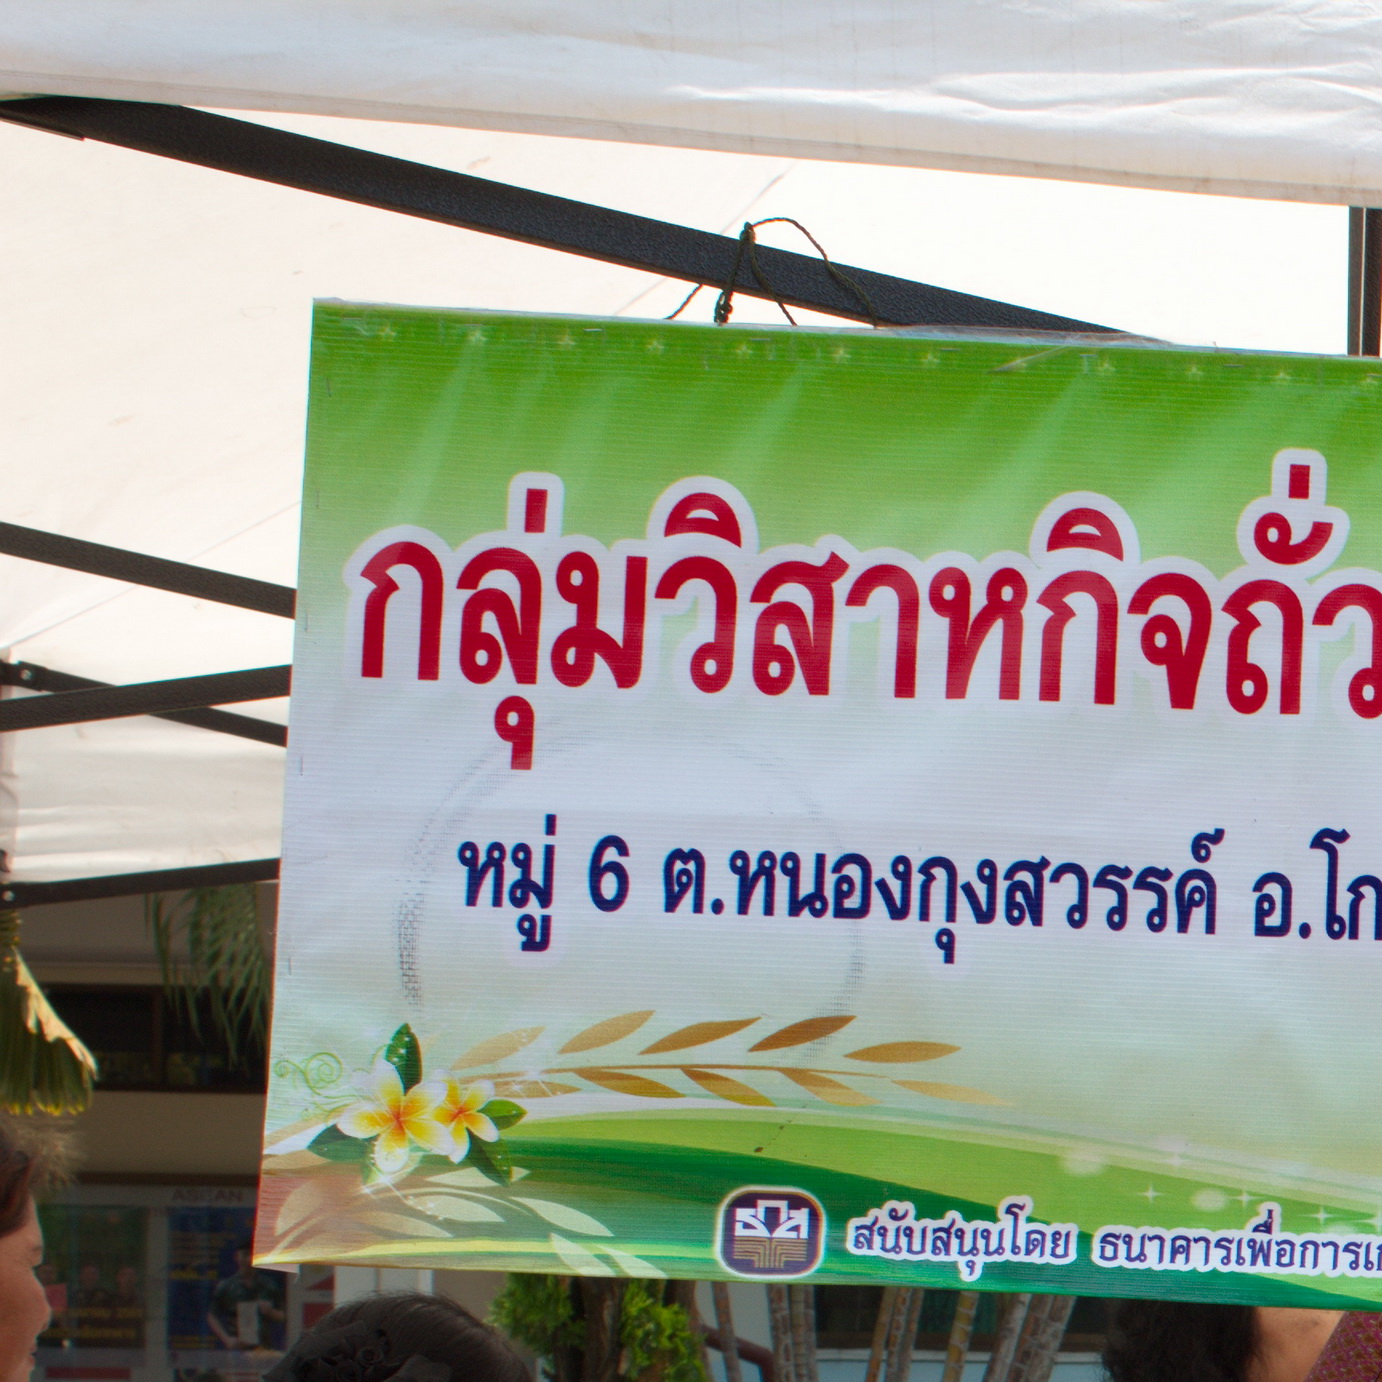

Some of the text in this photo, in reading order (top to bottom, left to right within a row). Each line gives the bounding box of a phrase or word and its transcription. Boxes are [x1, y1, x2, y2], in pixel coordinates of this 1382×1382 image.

[457, 813, 556, 953] หมู่
[588, 835, 629, 912] 6
[662, 827, 1226, 965] ต.หนองกุงสวรรค์
[853, 1203, 1071, 1275] สนับสนุนโดย
